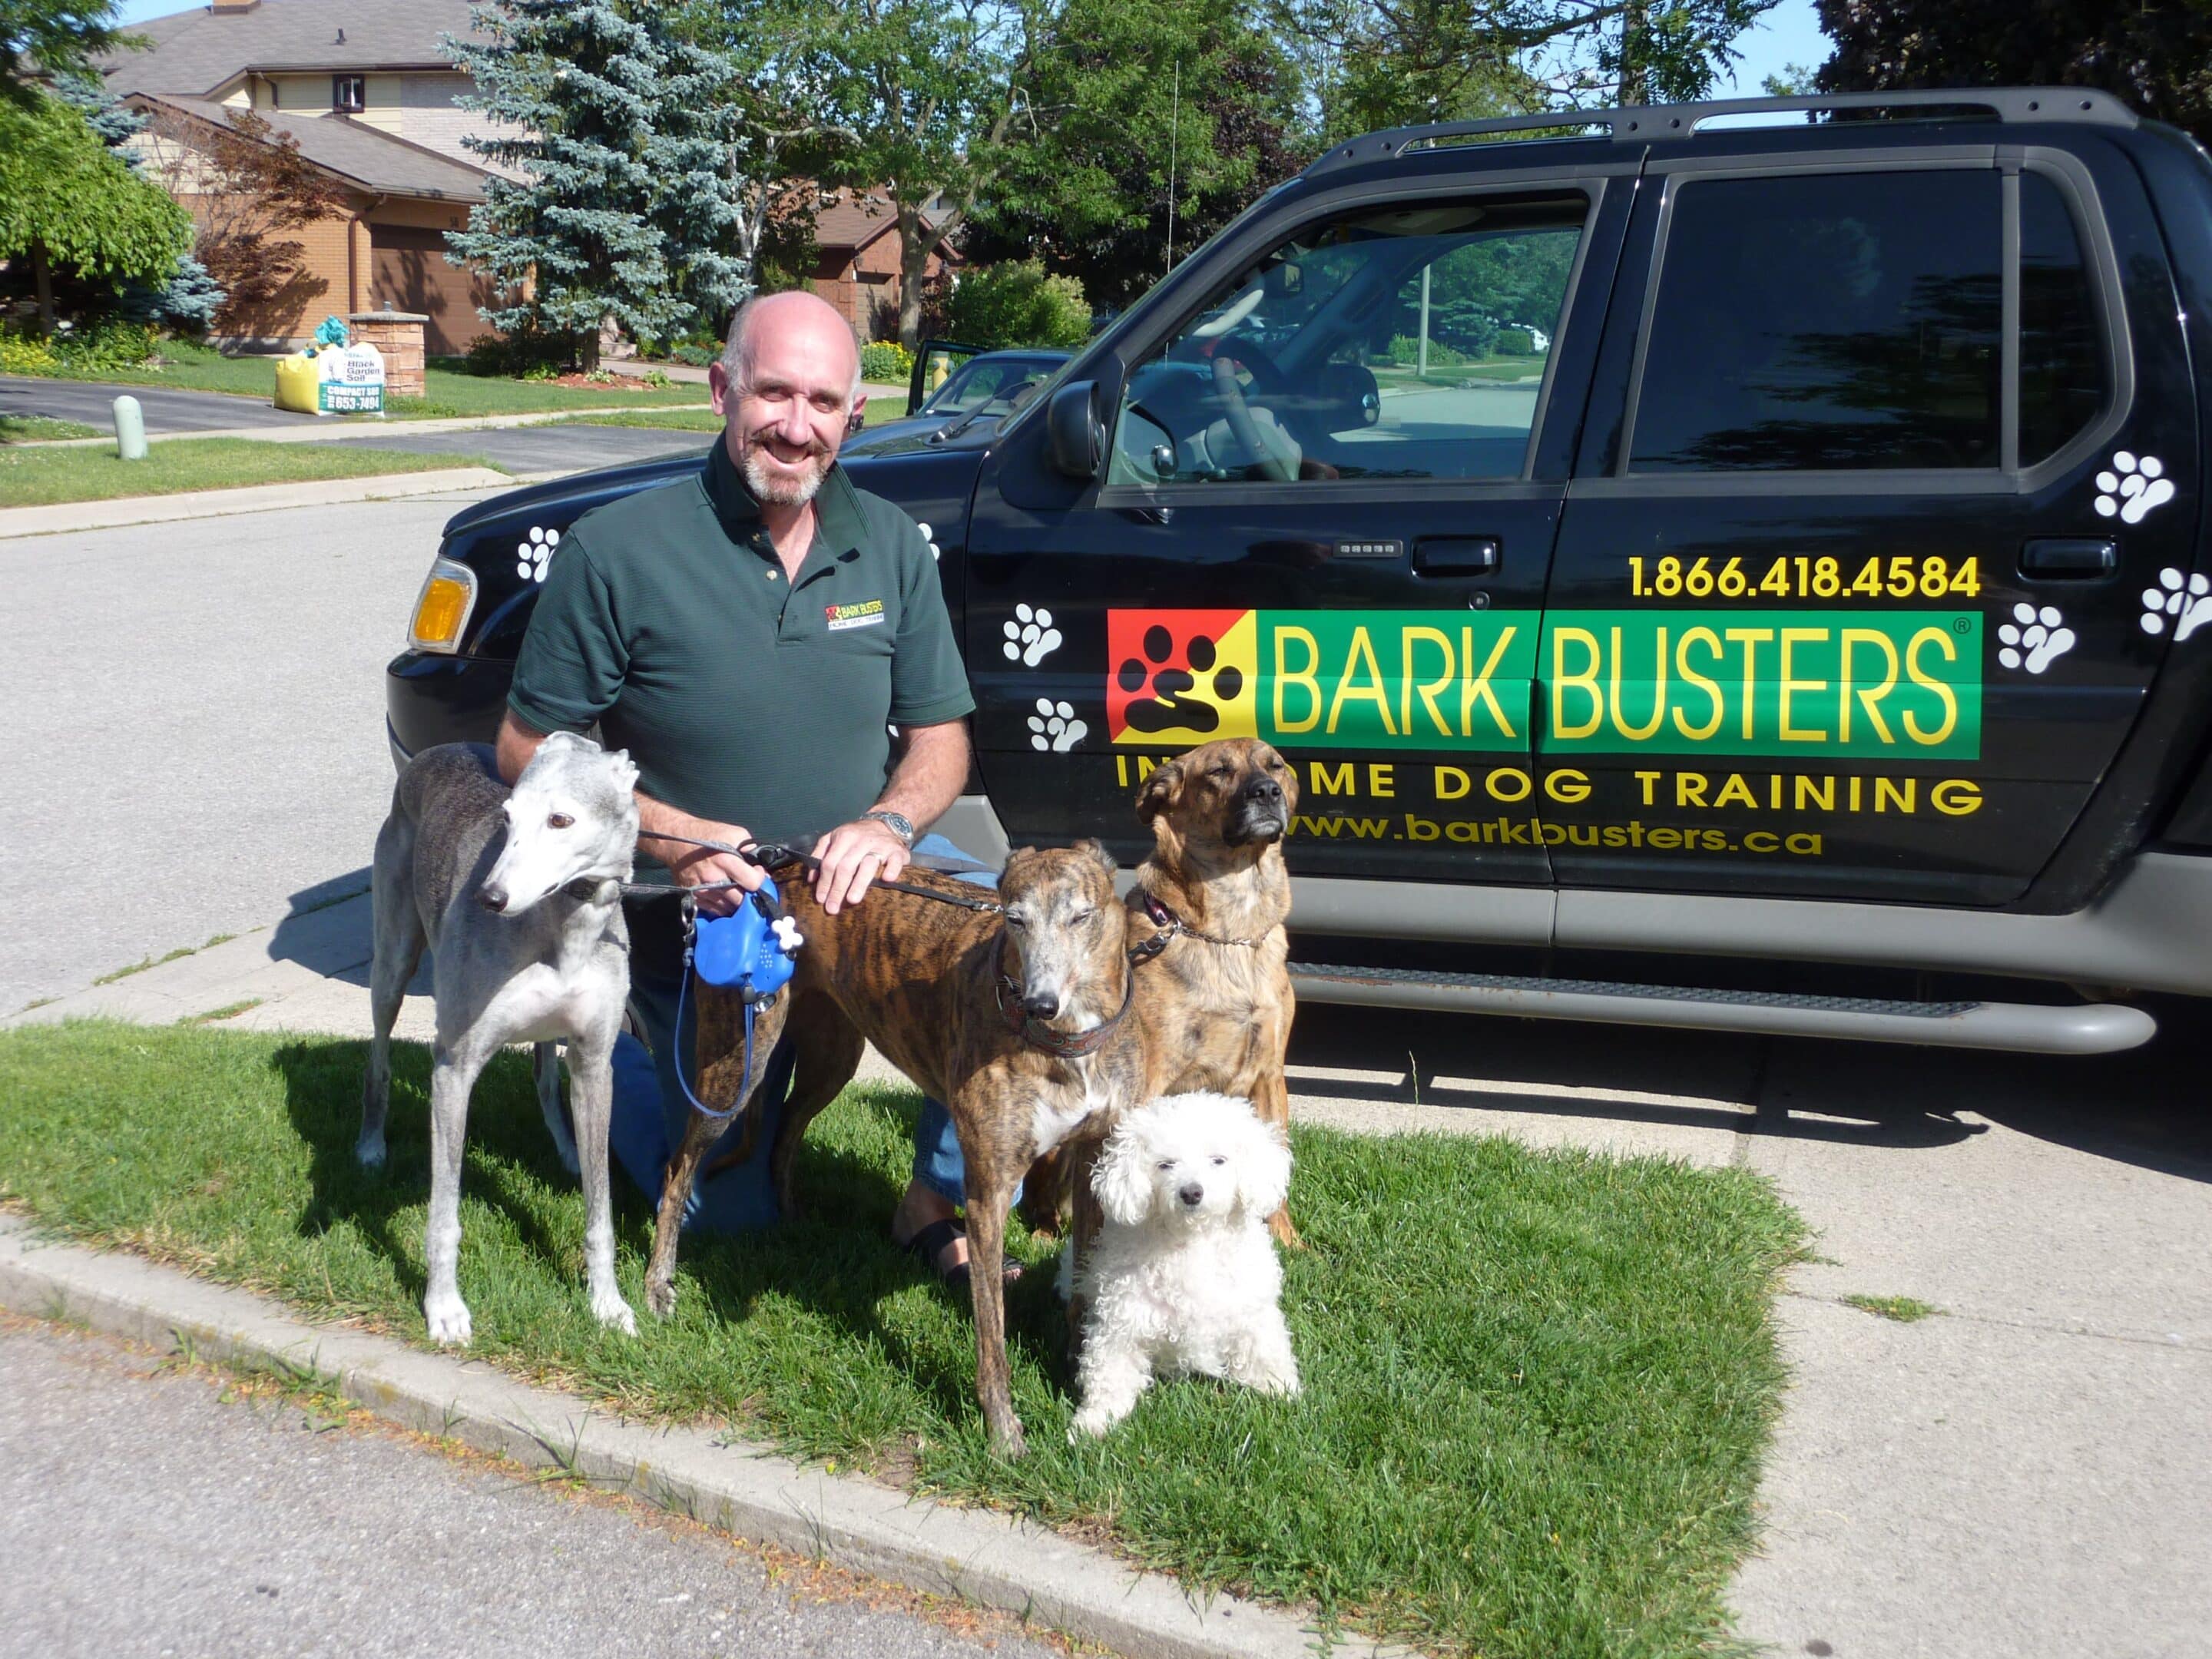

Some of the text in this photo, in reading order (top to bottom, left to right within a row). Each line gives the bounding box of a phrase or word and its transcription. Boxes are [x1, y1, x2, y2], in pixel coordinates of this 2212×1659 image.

[327, 386, 366, 396] COMPACT
[336, 396, 379, 409] 653-7494
[1628, 557, 1981, 597] 1.866.418.4584
[841, 604, 860, 618] BARK
[1273, 626, 1517, 737] BARK
[1435, 766, 1592, 803] DOG
[1634, 771, 1983, 816] TRAINING
[1286, 813, 1823, 855] ww.barkbusters.ca
